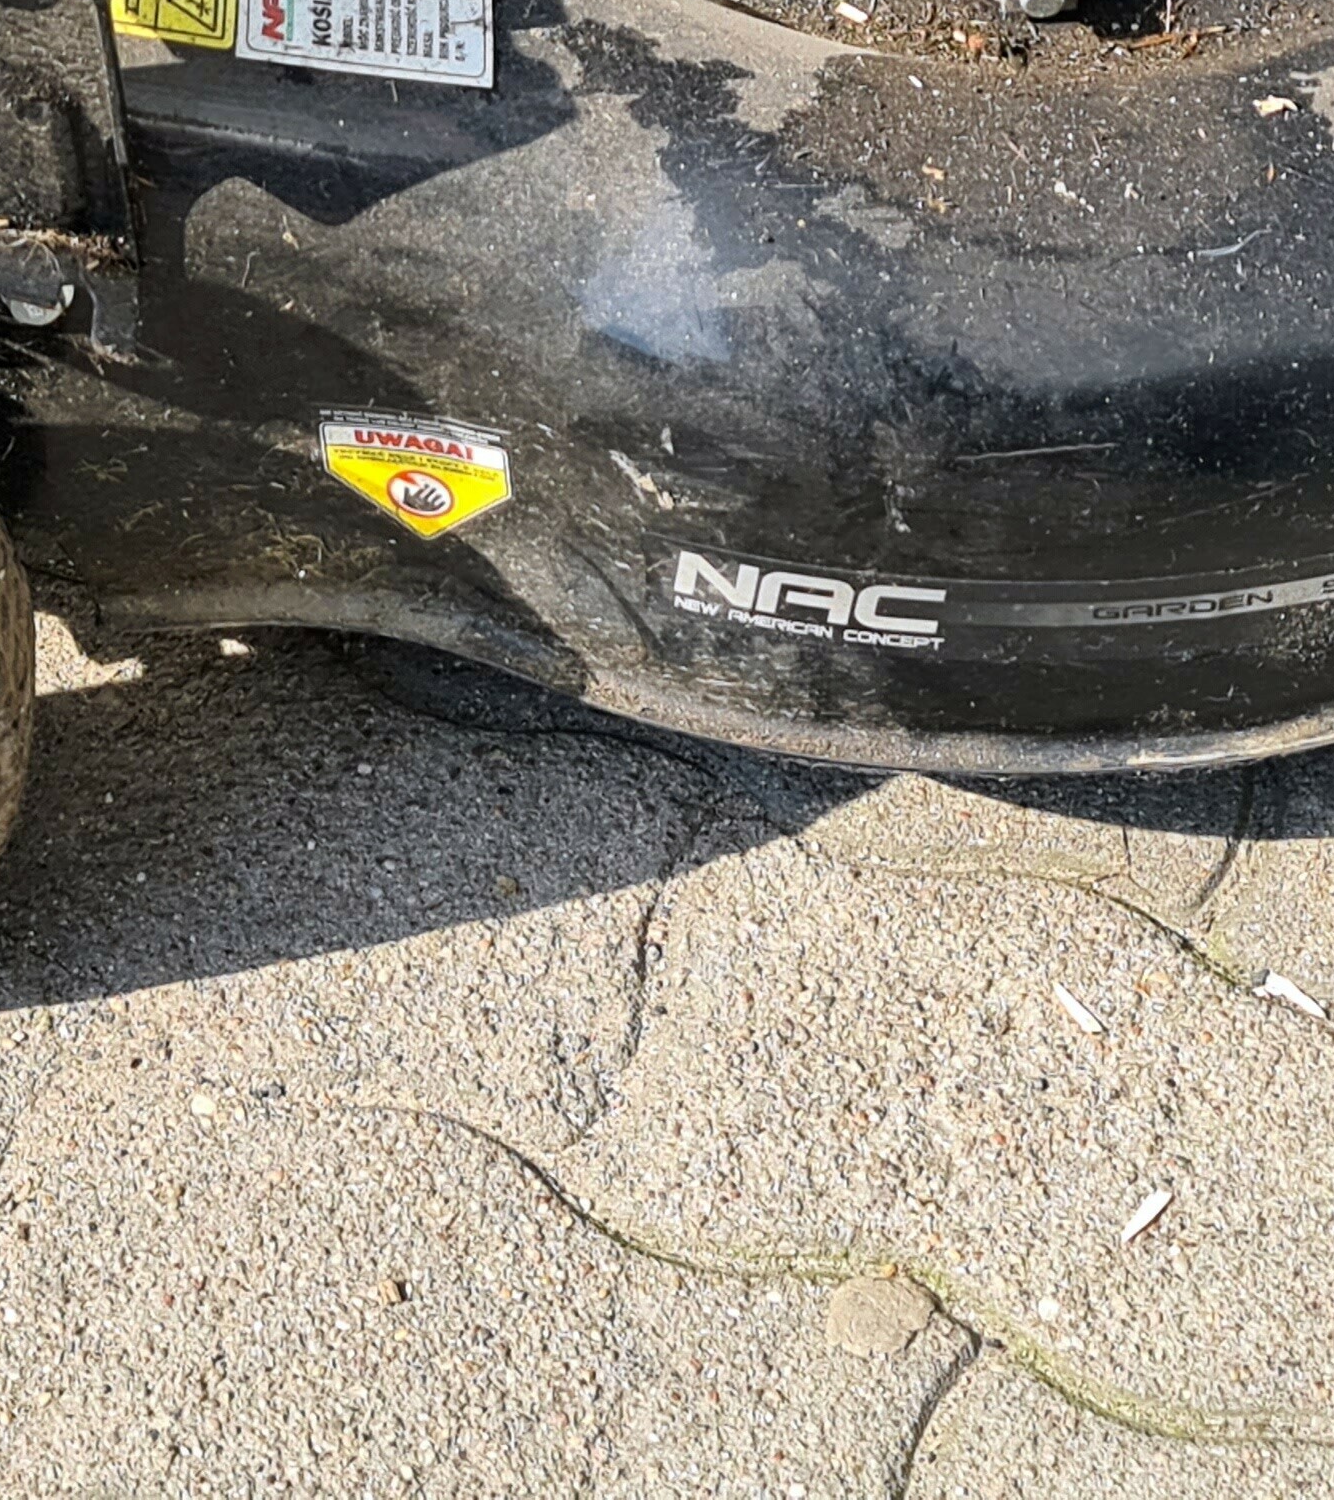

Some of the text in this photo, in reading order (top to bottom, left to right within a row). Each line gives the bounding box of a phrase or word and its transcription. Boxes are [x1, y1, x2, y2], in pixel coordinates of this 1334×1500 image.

[353, 429, 475, 461] UWAGA!
[673, 550, 947, 634] NAC
[1092, 590, 1274, 621] GARDEN
[673, 595, 945, 651] NEW AMERICAN CONCEPT
